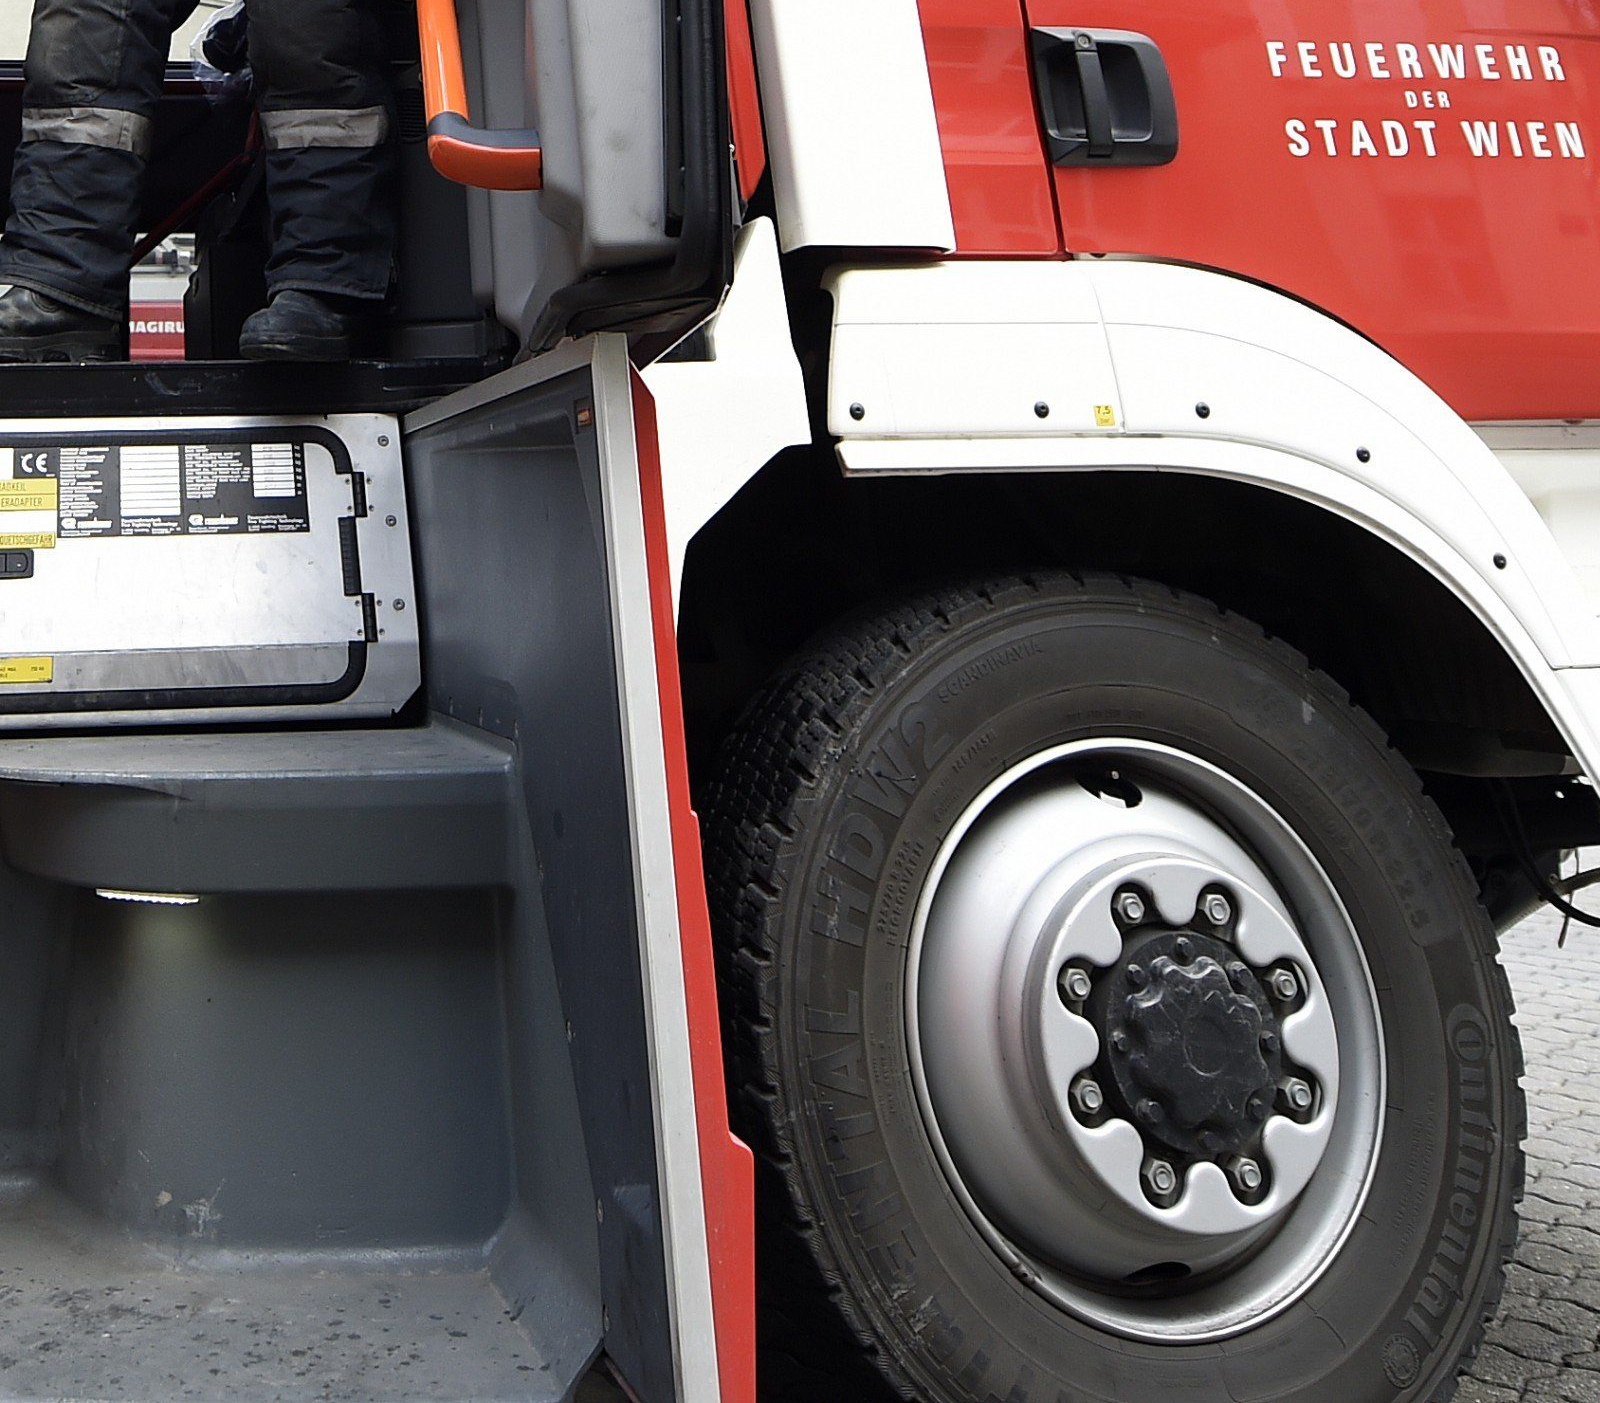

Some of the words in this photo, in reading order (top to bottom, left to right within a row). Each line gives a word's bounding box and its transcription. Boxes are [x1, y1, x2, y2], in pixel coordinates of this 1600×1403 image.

[1266, 42, 1566, 81] FEUERWEHR
[1404, 90, 1451, 109] DER
[1285, 119, 1438, 158] STADT
[1460, 121, 1586, 159] WIEN
[21, 453, 49, 473] CE
[1406, 1003, 1496, 1351] Continental
